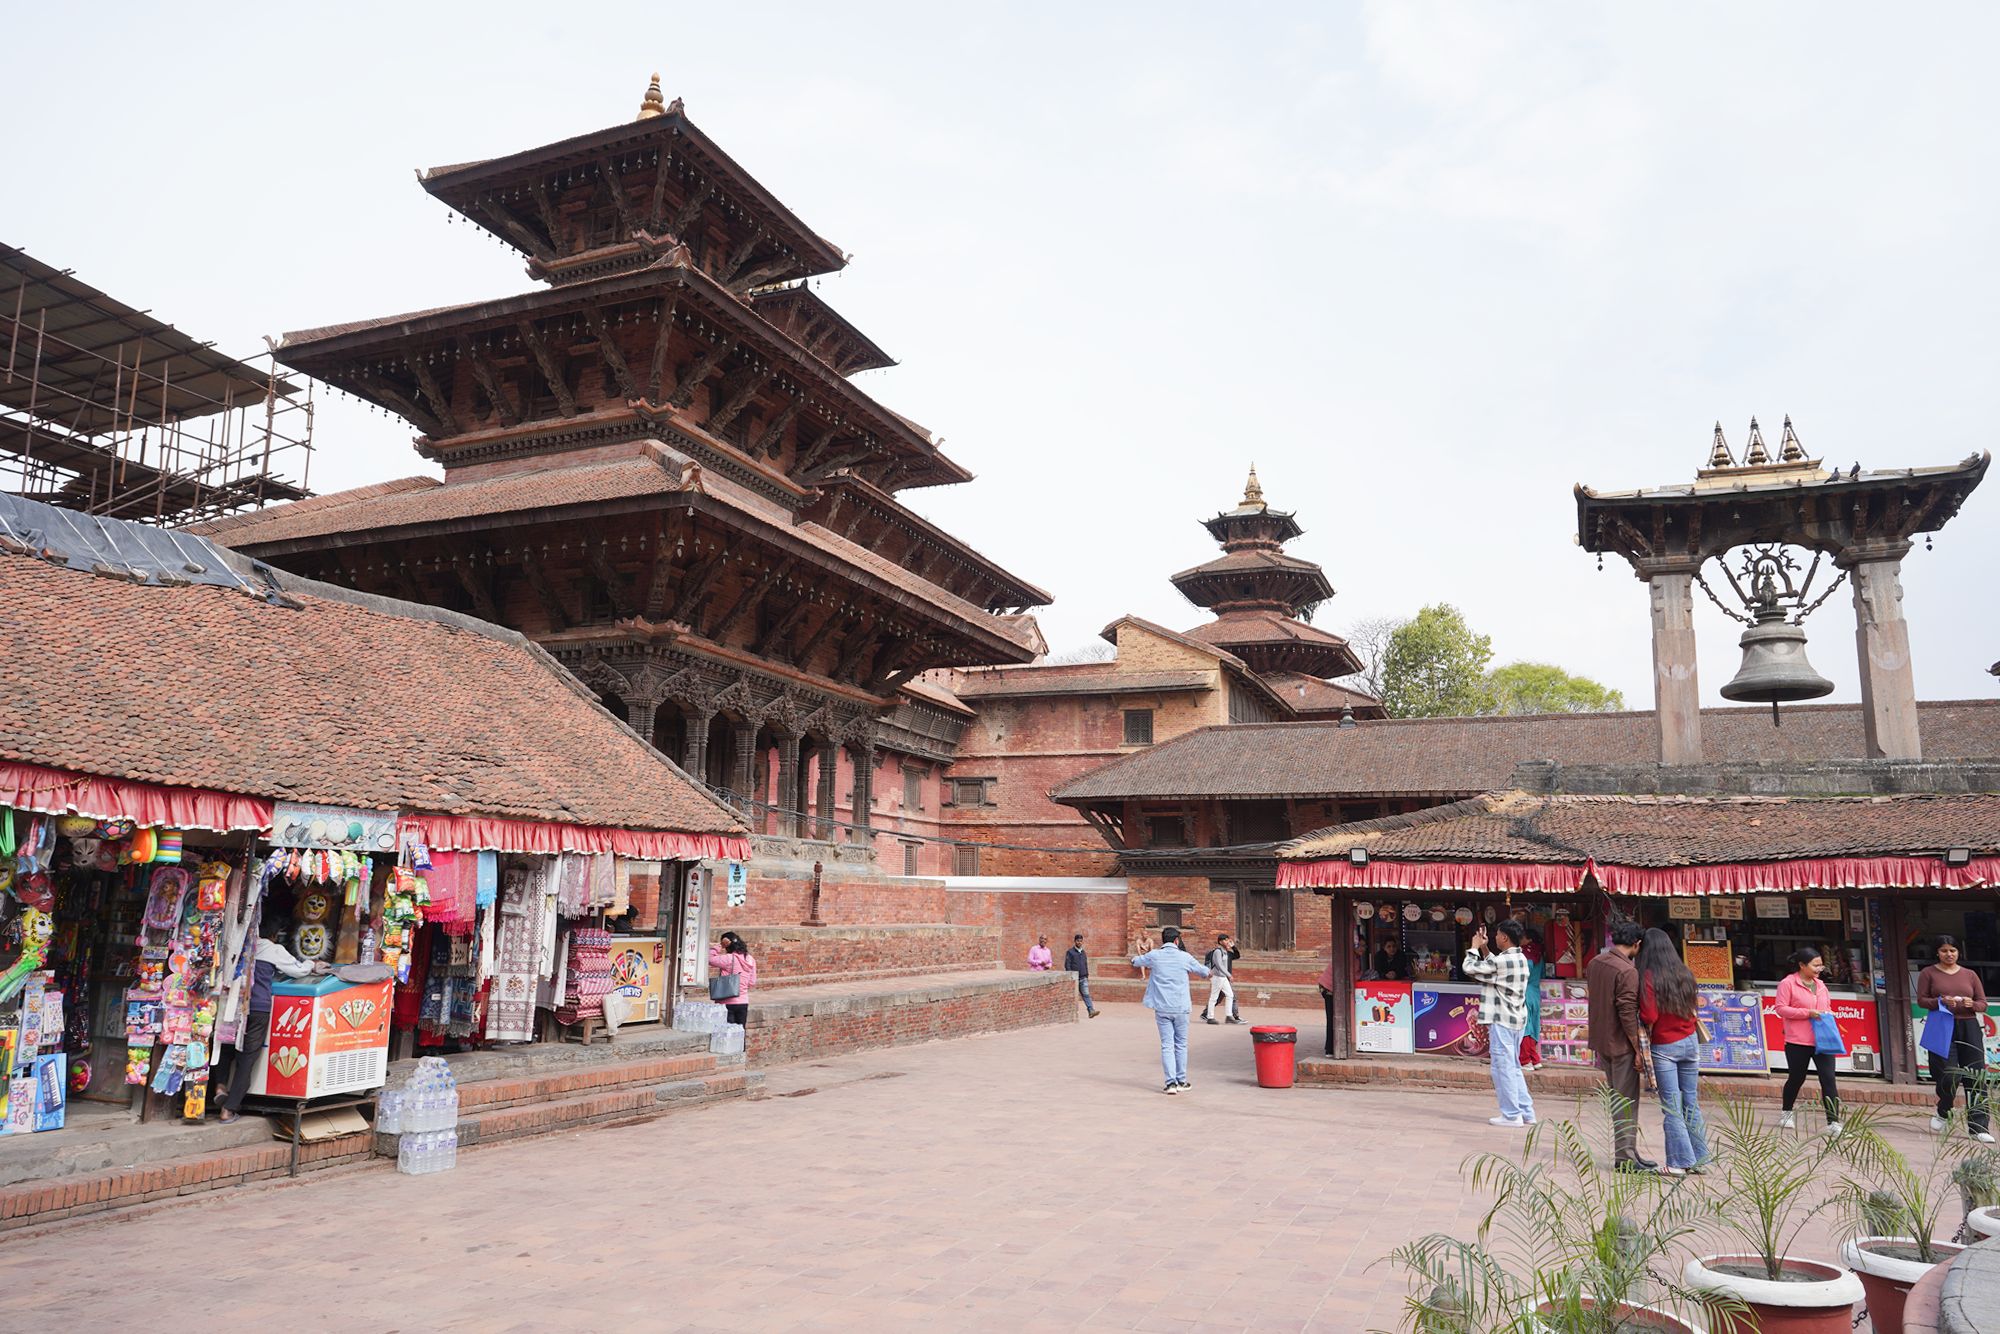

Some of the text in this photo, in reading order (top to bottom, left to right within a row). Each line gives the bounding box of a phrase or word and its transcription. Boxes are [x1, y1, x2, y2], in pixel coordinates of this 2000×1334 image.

[292, 805, 311, 813] weather
[316, 806, 330, 814] Good
[1464, 996, 1480, 1006] MA
